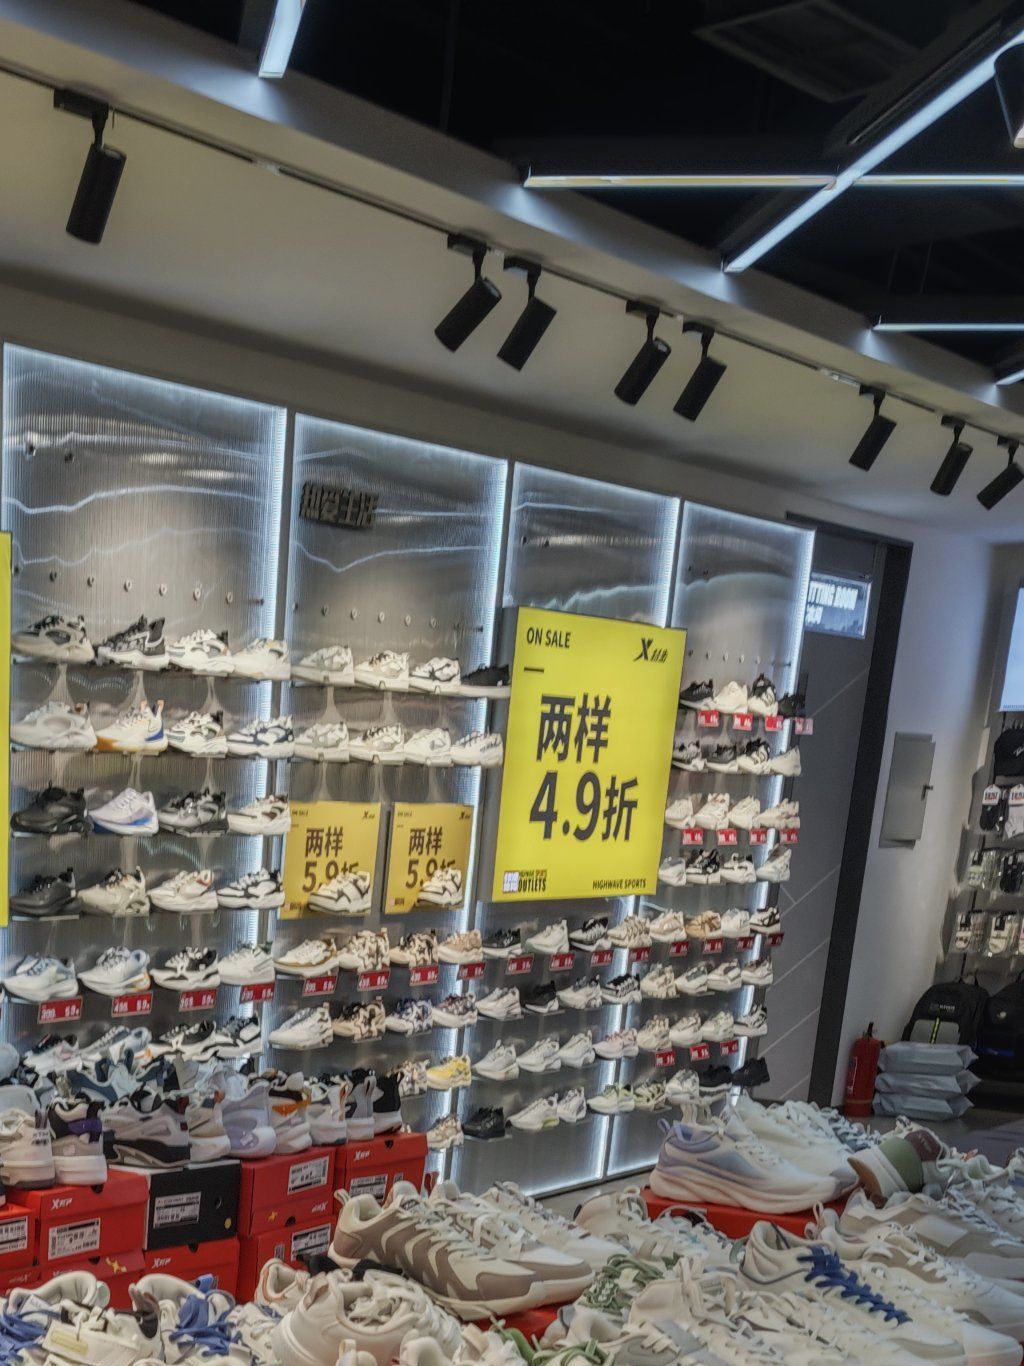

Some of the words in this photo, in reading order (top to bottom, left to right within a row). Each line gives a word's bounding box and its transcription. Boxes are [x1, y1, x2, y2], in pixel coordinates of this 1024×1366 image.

[526, 626, 544, 646] ON
[544, 629, 572, 650] SALE
[535, 692, 612, 764] 两样
[529, 769, 639, 842] 4.9折
[304, 826, 344, 858] 两样
[407, 826, 444, 858] 两样
[518, 878, 547, 893] OUTLETS
